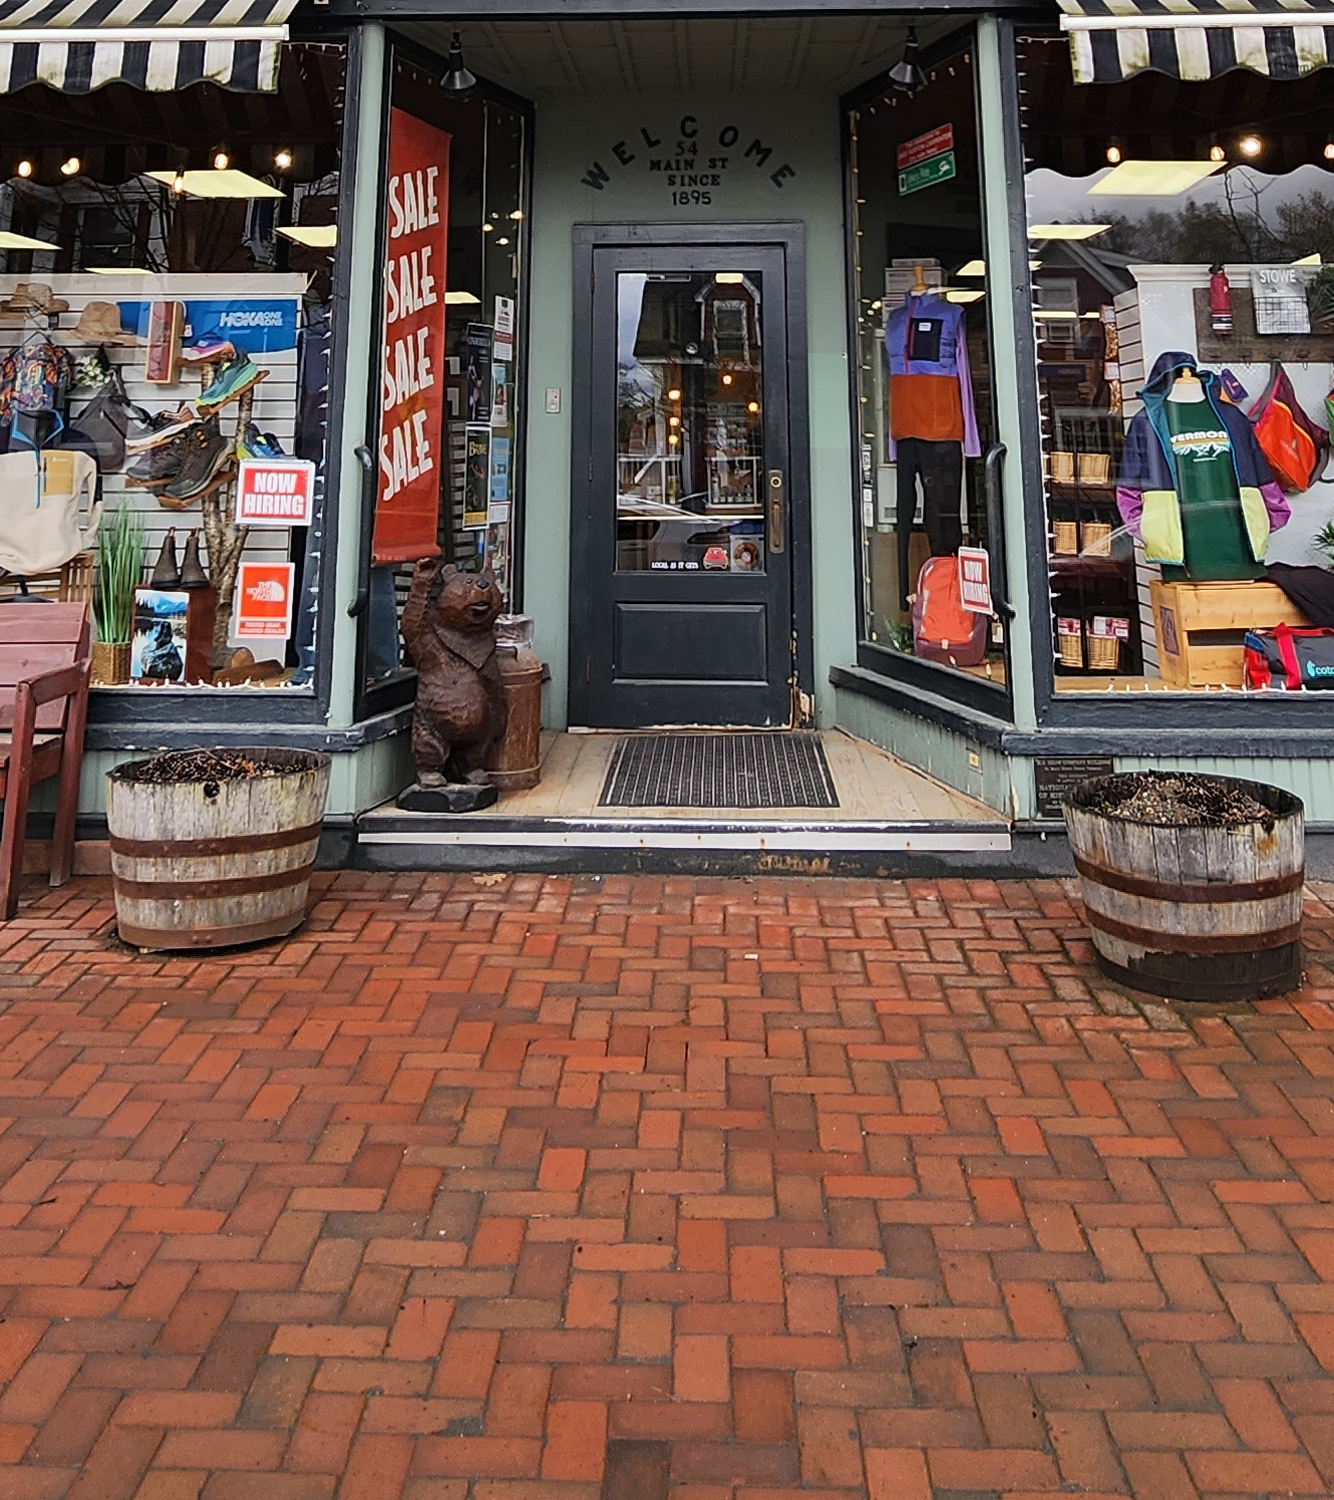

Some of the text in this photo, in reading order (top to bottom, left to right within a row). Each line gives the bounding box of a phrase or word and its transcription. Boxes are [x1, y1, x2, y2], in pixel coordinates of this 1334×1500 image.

[580, 115, 796, 192] WELCOME
[675, 141, 698, 157] 54
[649, 157, 730, 171] MAIN ST
[667, 174, 721, 187] SINCE
[388, 166, 439, 239] SALE
[671, 190, 712, 206] 1895
[386, 245, 437, 323] SALE
[1259, 269, 1297, 283] STOWE
[219, 311, 265, 328] HOKA
[383, 326, 435, 411] SALE
[1169, 430, 1228, 444] VERMON
[379, 409, 434, 501] SALE
[254, 472, 298, 494] NOW
[243, 493, 304, 516] HIRING
[963, 560, 983, 583] NOW
[962, 580, 988, 605] HIRING
[1039, 784, 1069, 792] NATIONA
